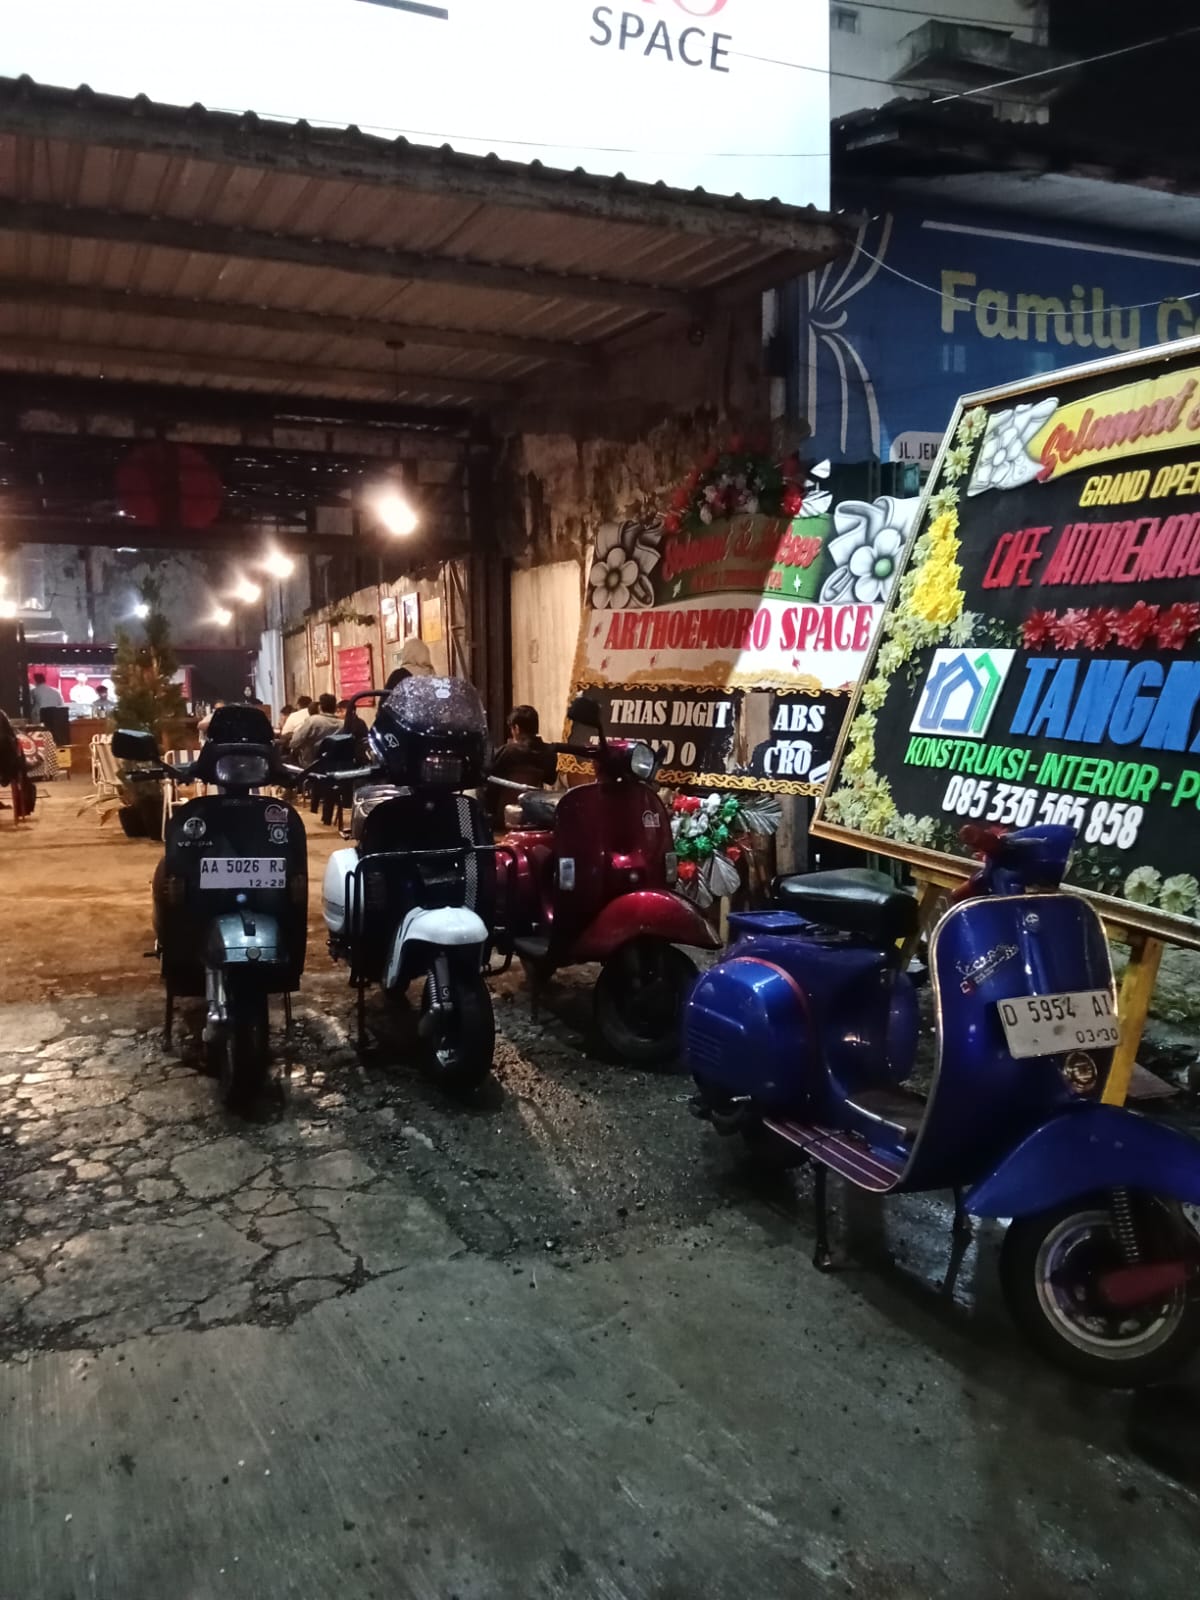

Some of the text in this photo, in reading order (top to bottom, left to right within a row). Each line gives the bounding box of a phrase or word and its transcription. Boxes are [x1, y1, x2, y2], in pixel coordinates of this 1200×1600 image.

[590, 6, 733, 73] SPACE
[941, 270, 1200, 351] Family G
[899, 441, 942, 460] JL. JEN
[1037, 378, 1199, 484] Selamat
[1078, 469, 1150, 507] GRAND
[981, 526, 1053, 590] CAFE
[603, 605, 874, 651] ARTHOEMORO SPACE
[610, 699, 826, 732] TRIAS DIGIT ABS
[1009, 657, 1200, 754] TANGK
[942, 775, 992, 818] 085
[986, 782, 1039, 828] 336
[1085, 801, 1144, 850] 858
[201, 860, 219, 874] AA
[226, 859, 260, 873] 5026
[1002, 1004, 1018, 1027] D
